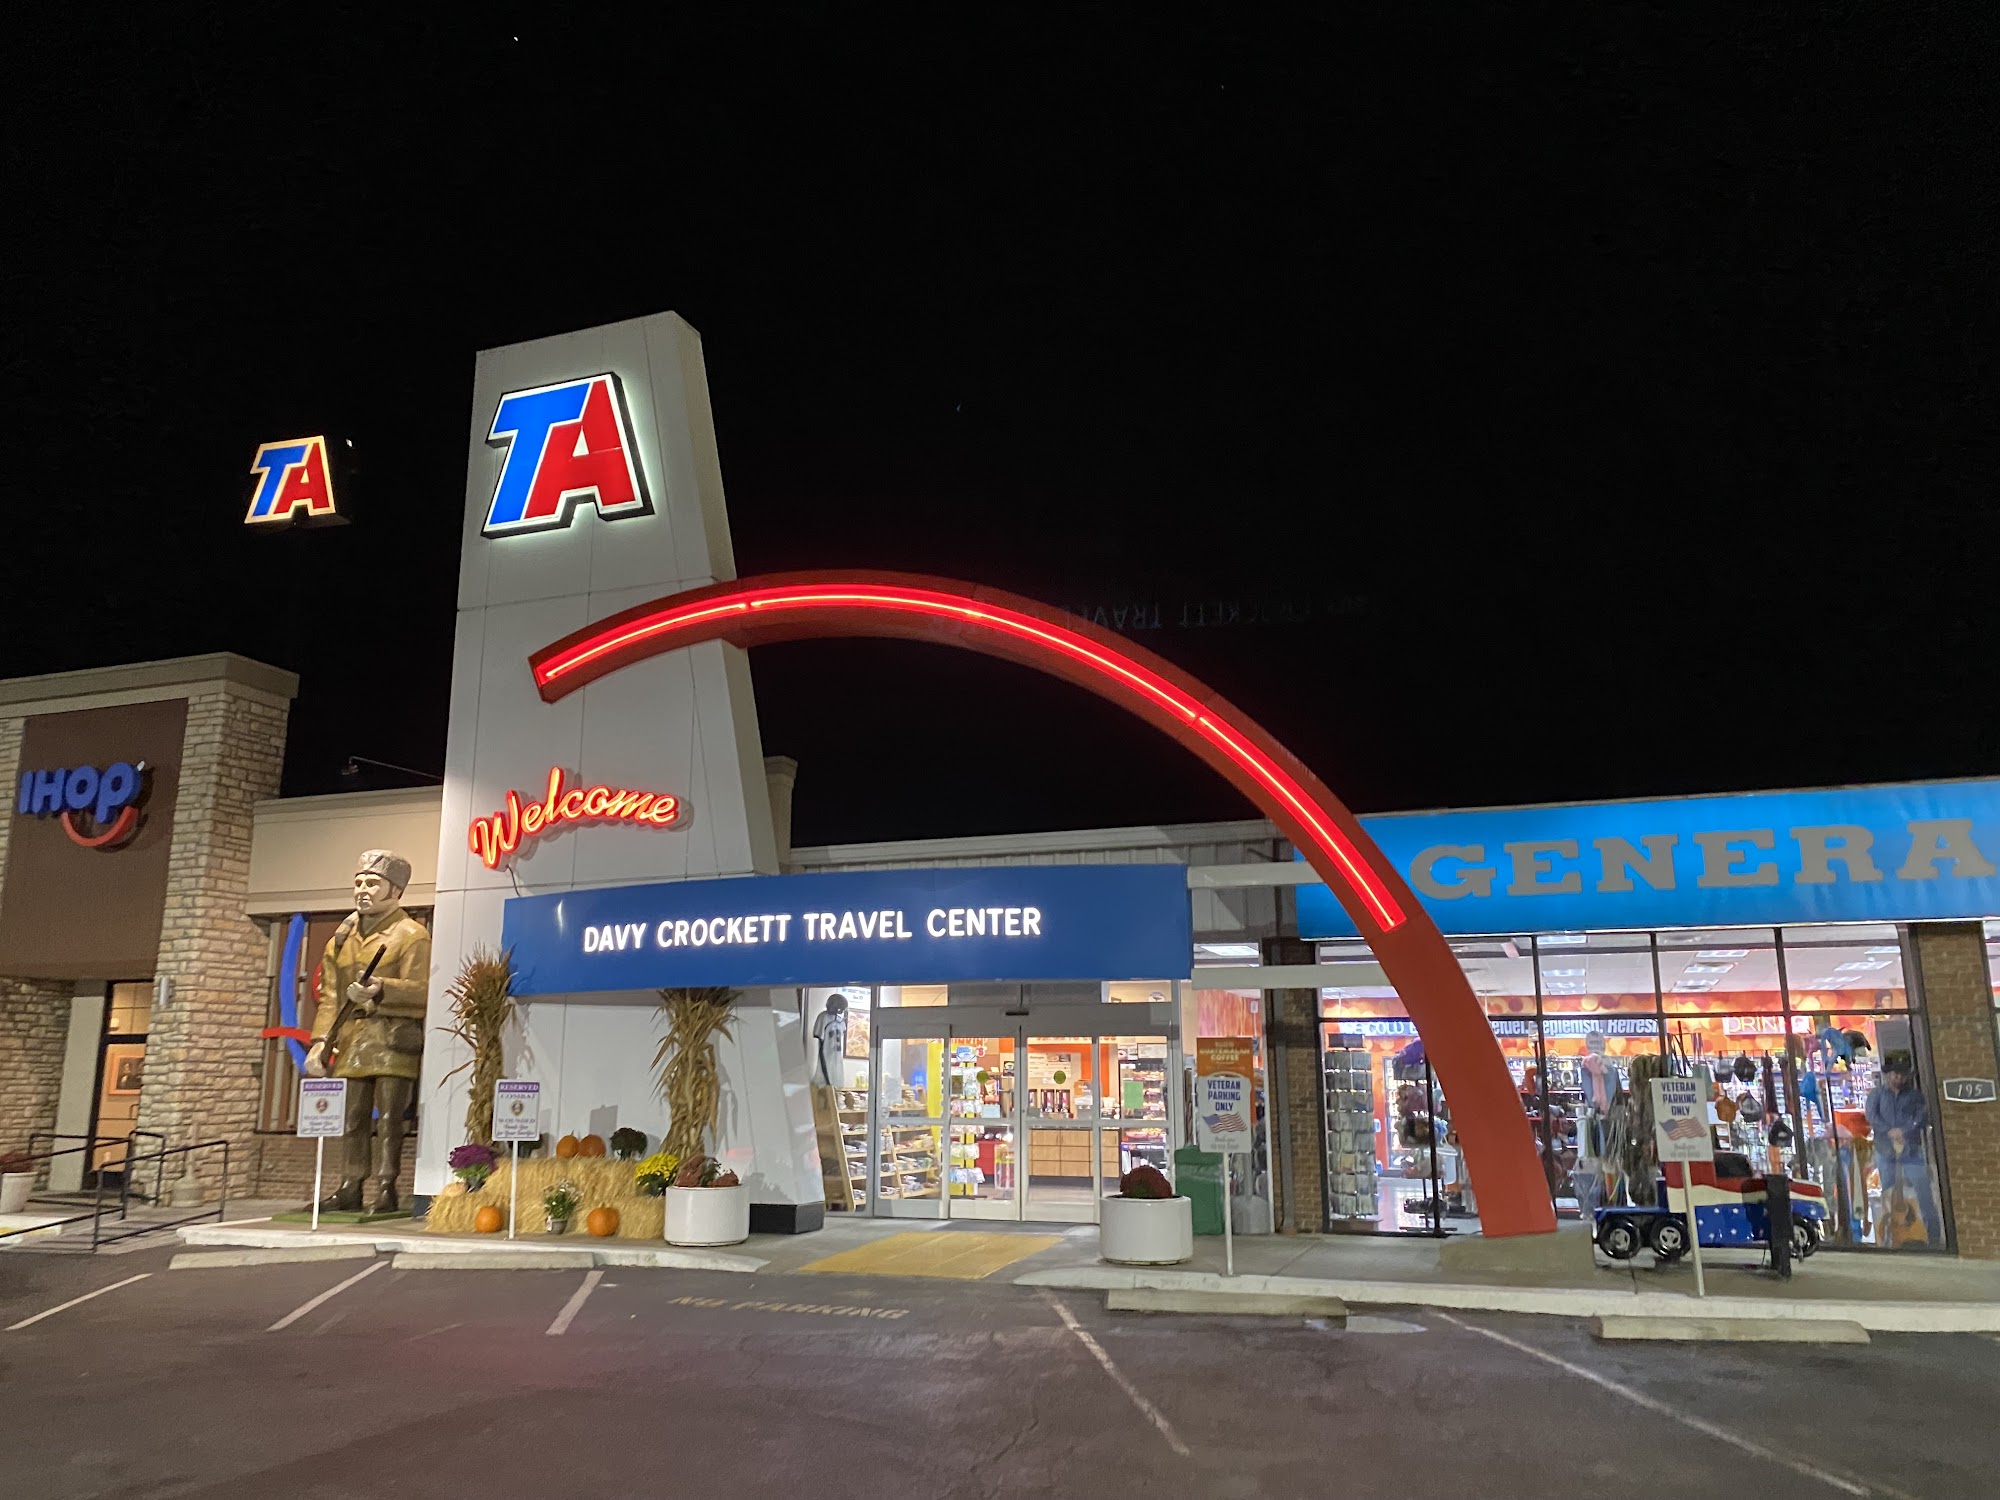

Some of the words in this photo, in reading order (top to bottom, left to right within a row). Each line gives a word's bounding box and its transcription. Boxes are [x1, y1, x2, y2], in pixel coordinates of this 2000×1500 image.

[488, 374, 642, 530] TA
[244, 435, 336, 524] TA
[19, 762, 137, 823] IHOP
[468, 767, 680, 869] Welcome
[1409, 818, 1996, 900] GENERA
[583, 922, 648, 953] DAVY
[657, 914, 792, 948] CROCKETT
[804, 910, 913, 941] TRAVEL
[926, 907, 1042, 937] CENTER
[1367, 1021, 1404, 1034] COLD
[1489, 1019, 1529, 1035] efuel.
[1543, 1019, 1603, 1036] eplenish.
[1210, 1054, 1240, 1062] COFFEE
[1207, 1080, 1241, 1090] VETERAN
[1661, 1082, 1696, 1092] VETERAN
[1957, 1083, 1983, 1098] 195
[1207, 1091, 1241, 1101] PARKING
[1662, 1093, 1697, 1104] PARKING
[1215, 1102, 1234, 1112] ONLY
[1671, 1106, 1690, 1116] ONLY
[729, 1300, 910, 1319] PARKING
